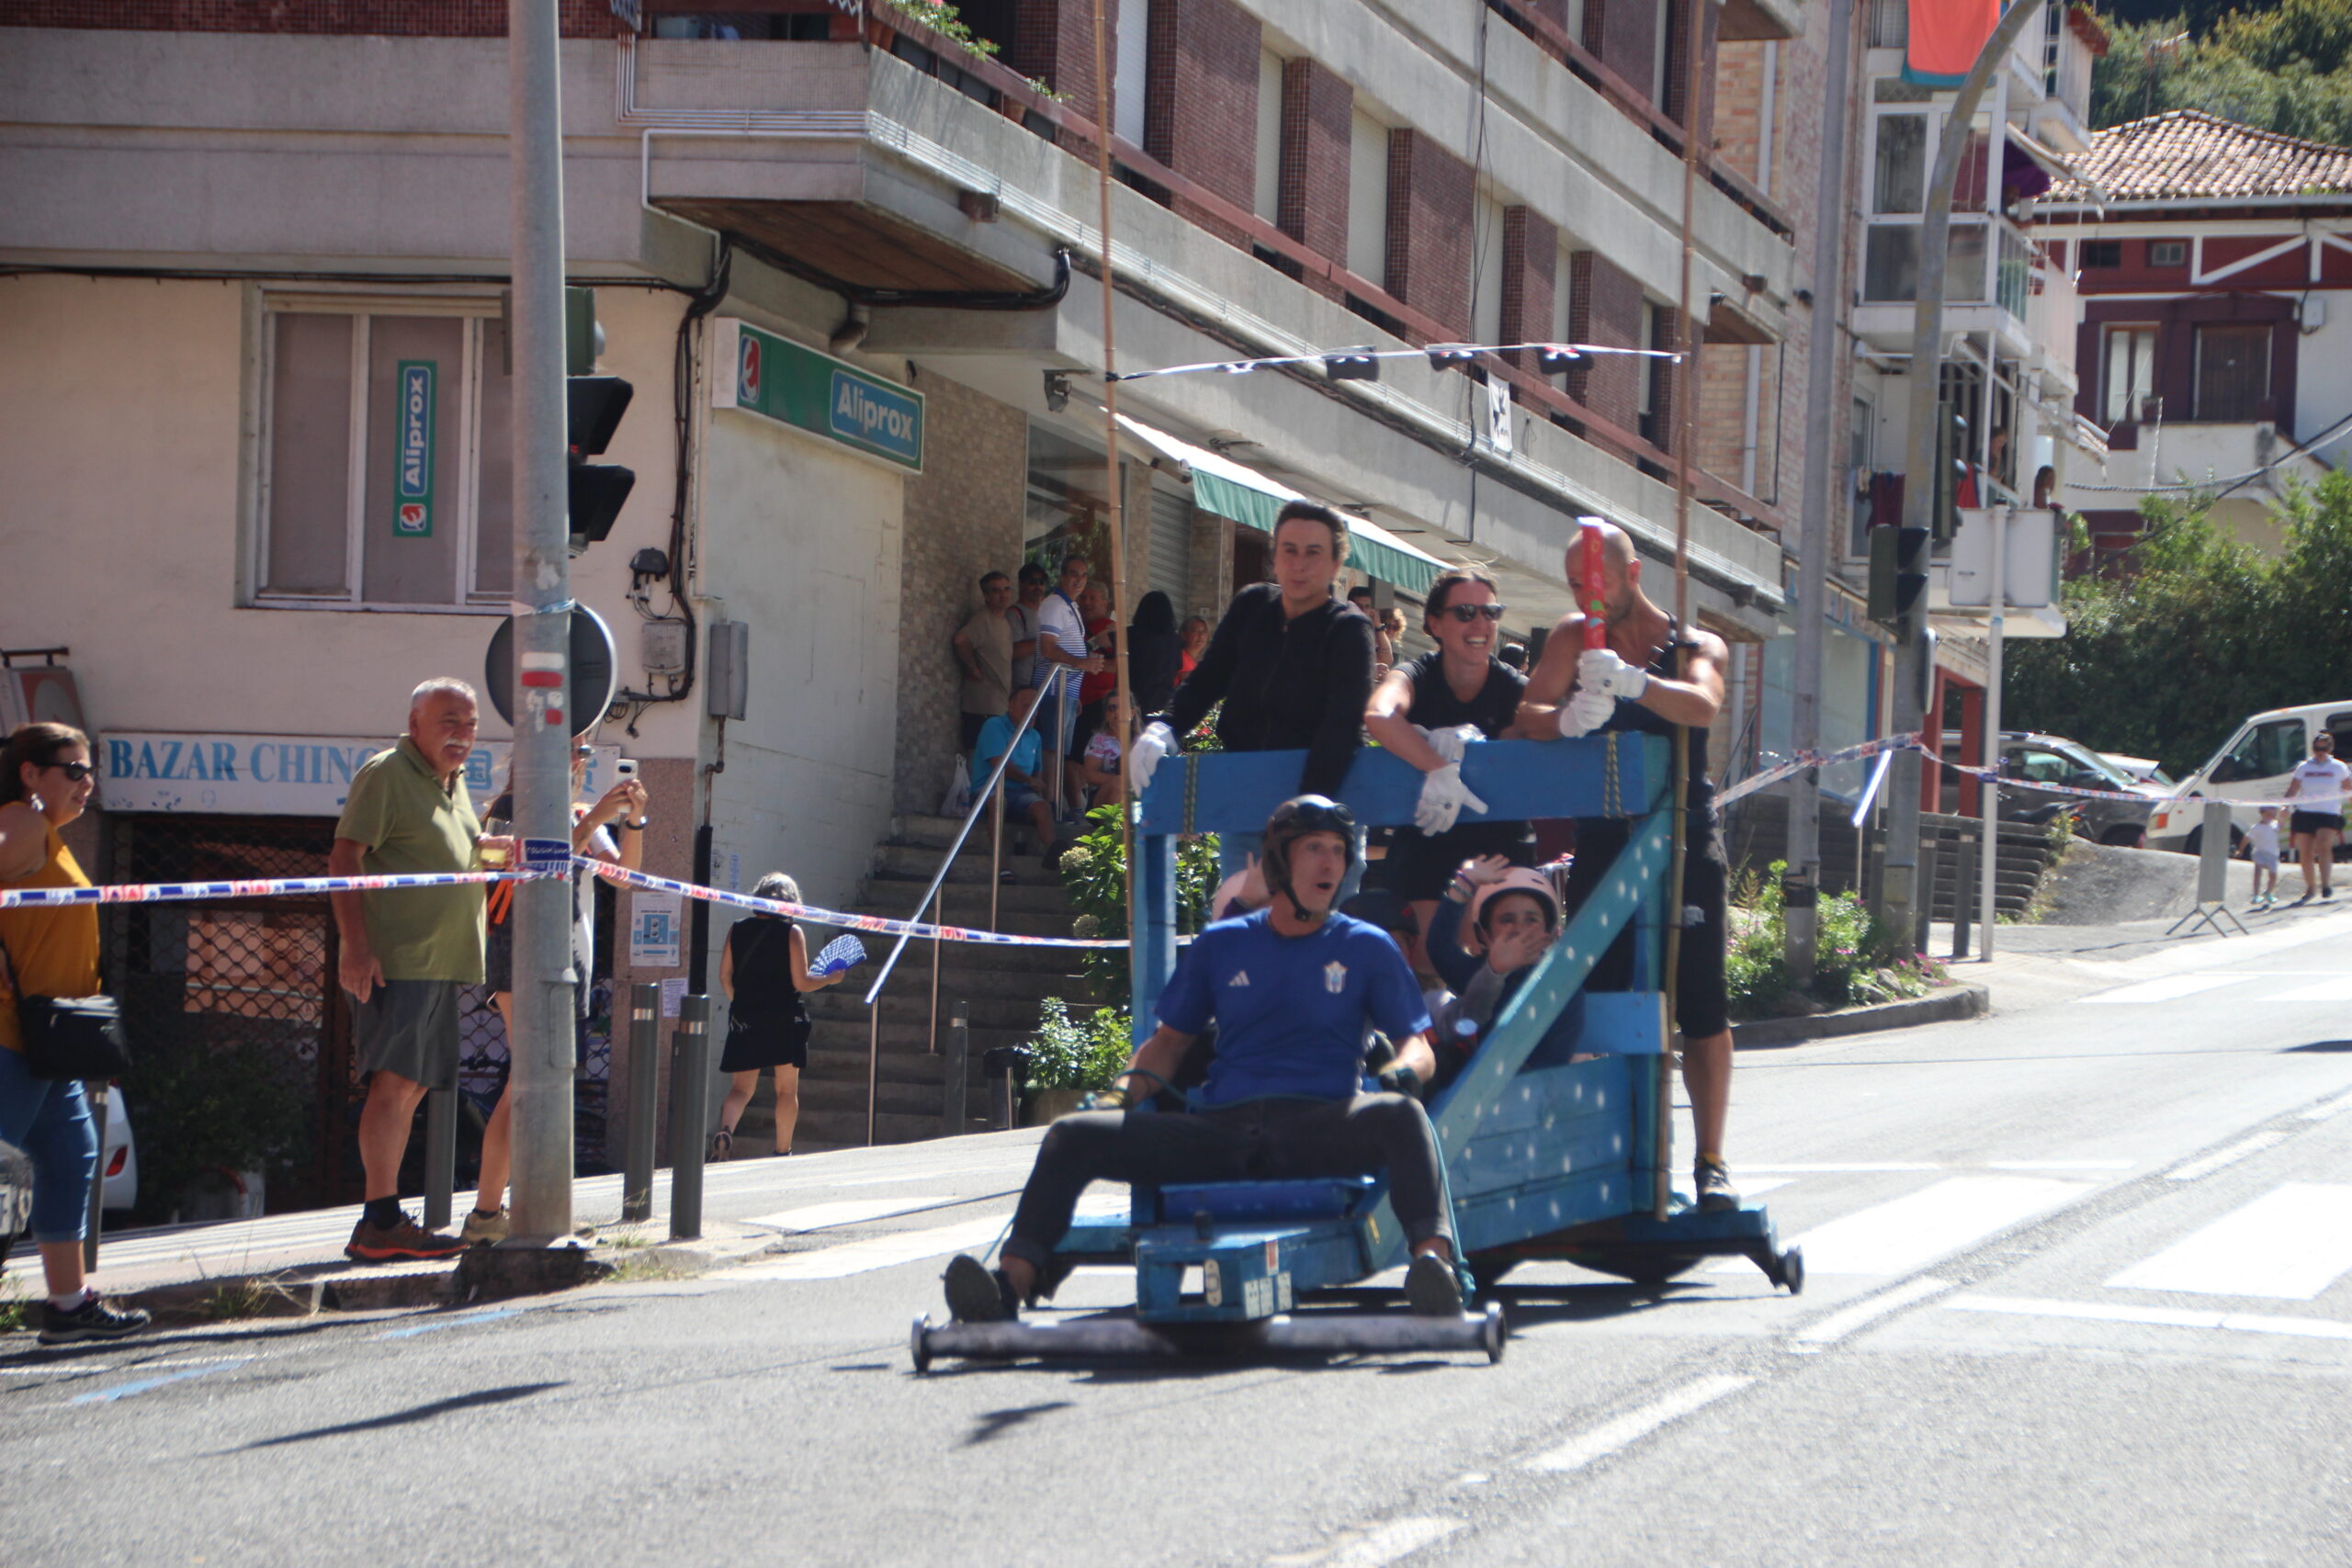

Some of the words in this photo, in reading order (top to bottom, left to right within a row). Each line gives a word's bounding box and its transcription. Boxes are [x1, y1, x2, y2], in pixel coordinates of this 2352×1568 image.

[405, 376, 424, 488] Aliprox
[837, 382, 913, 442] Aliprox
[107, 739, 239, 782] BAZAR
